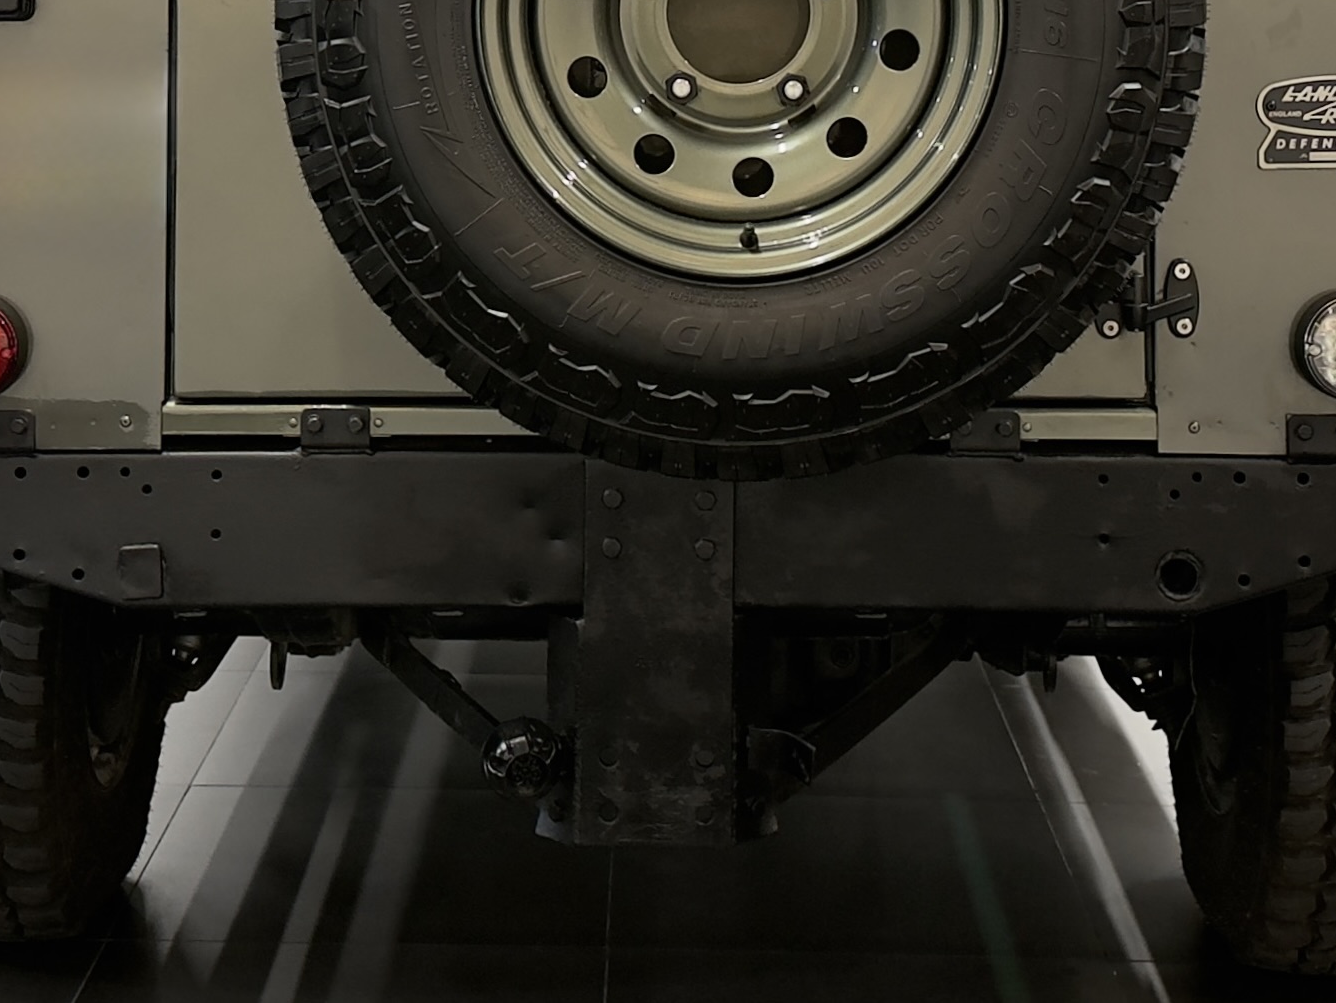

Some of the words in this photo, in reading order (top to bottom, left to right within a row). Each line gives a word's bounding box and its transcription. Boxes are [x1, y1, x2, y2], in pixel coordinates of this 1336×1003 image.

[397, 0, 440, 116] ROTATION
[1268, 110, 1303, 118] ENGLAND
[656, 83, 1076, 361] CROSSWIND
